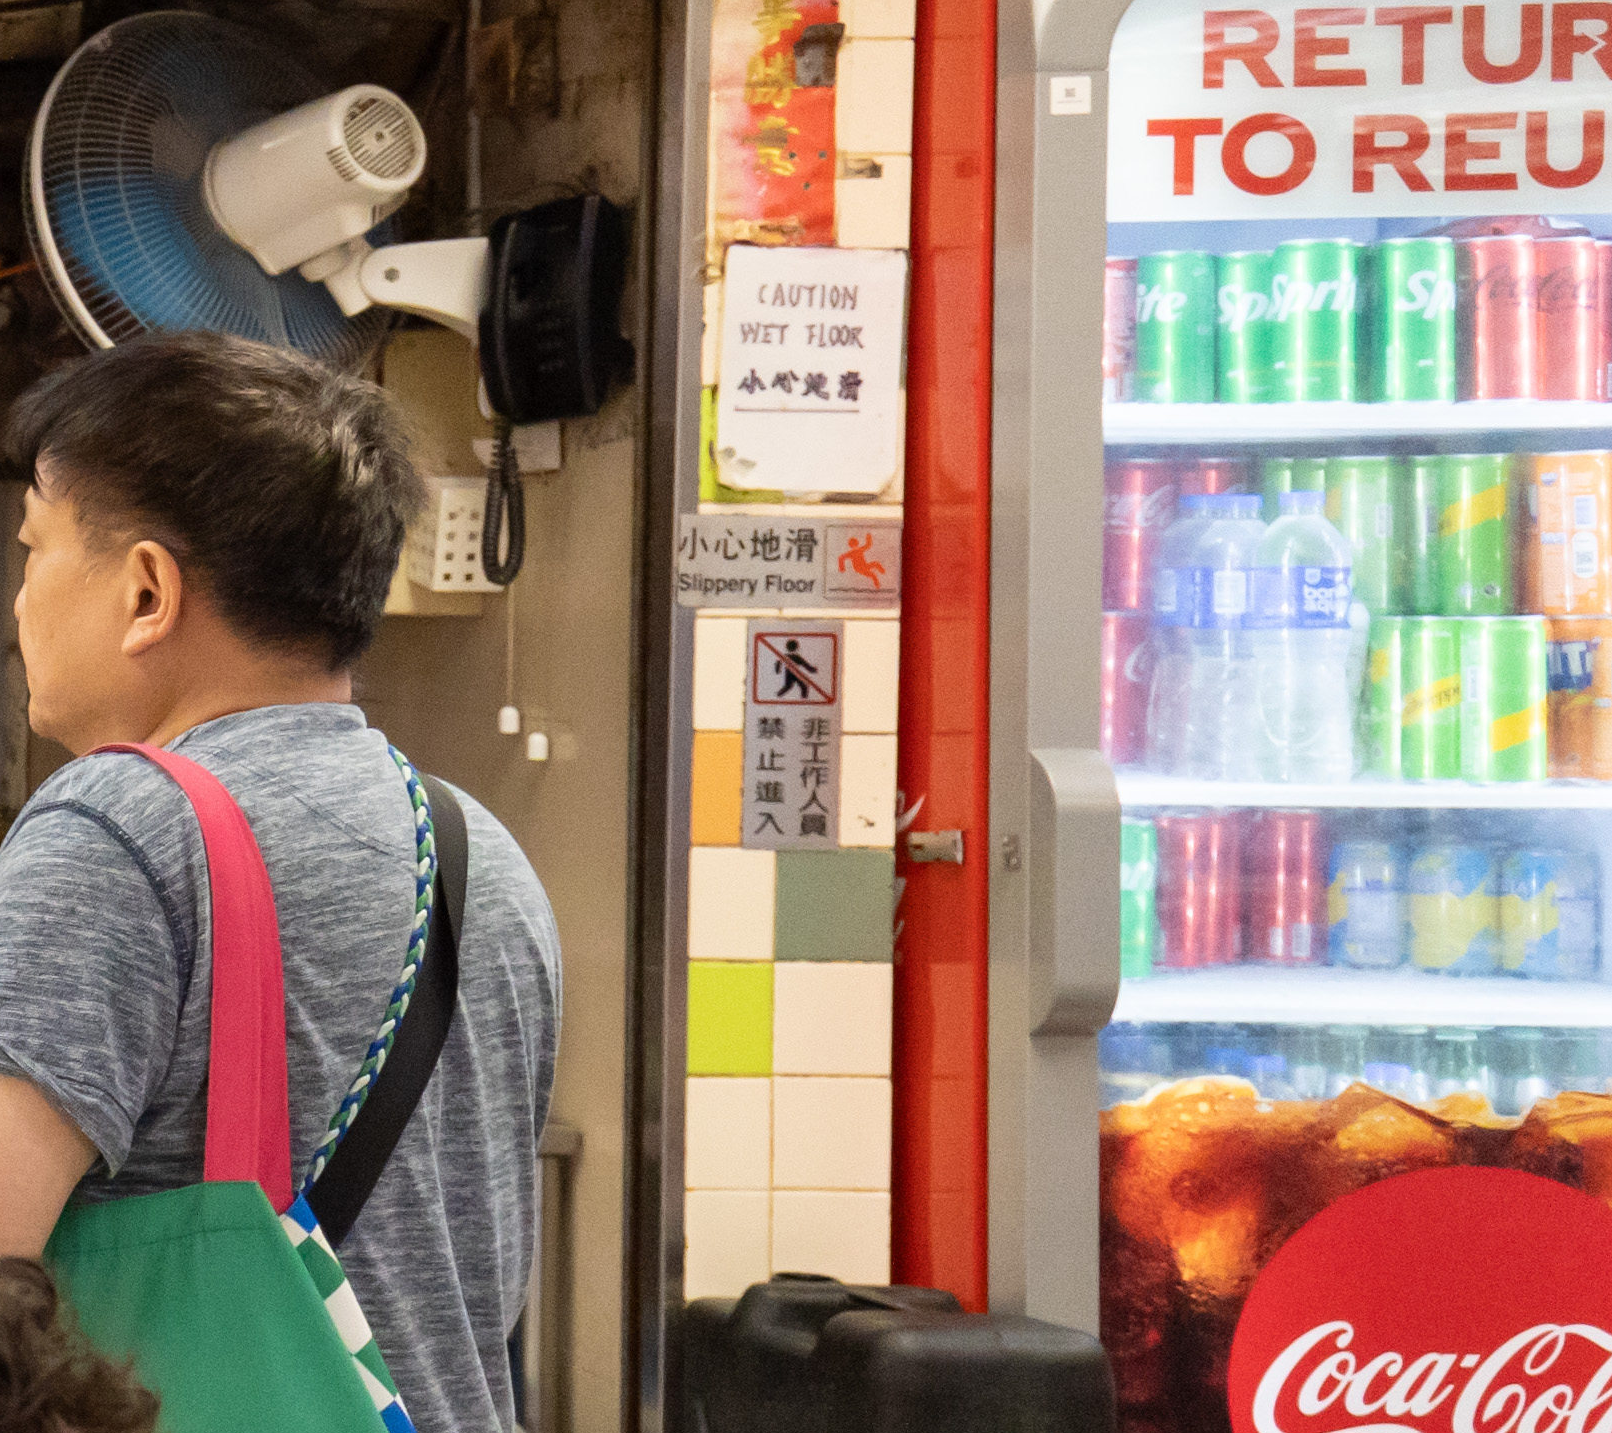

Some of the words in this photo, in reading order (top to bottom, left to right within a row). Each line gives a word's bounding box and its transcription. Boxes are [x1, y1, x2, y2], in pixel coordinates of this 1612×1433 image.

[1146, 113, 1317, 196] TO
[1351, 110, 1605, 193] REU
[757, 283, 858, 310] CAUTION
[740, 322, 788, 346] WET
[805, 323, 864, 350] FLOOR
[737, 369, 863, 403] 小心地滑
[679, 527, 818, 563] 小心地滑
[679, 572, 758, 596] Slippery
[765, 572, 816, 594] Floor
[755, 718, 786, 836] 禁止進入
[800, 717, 831, 837] 非工作人員
